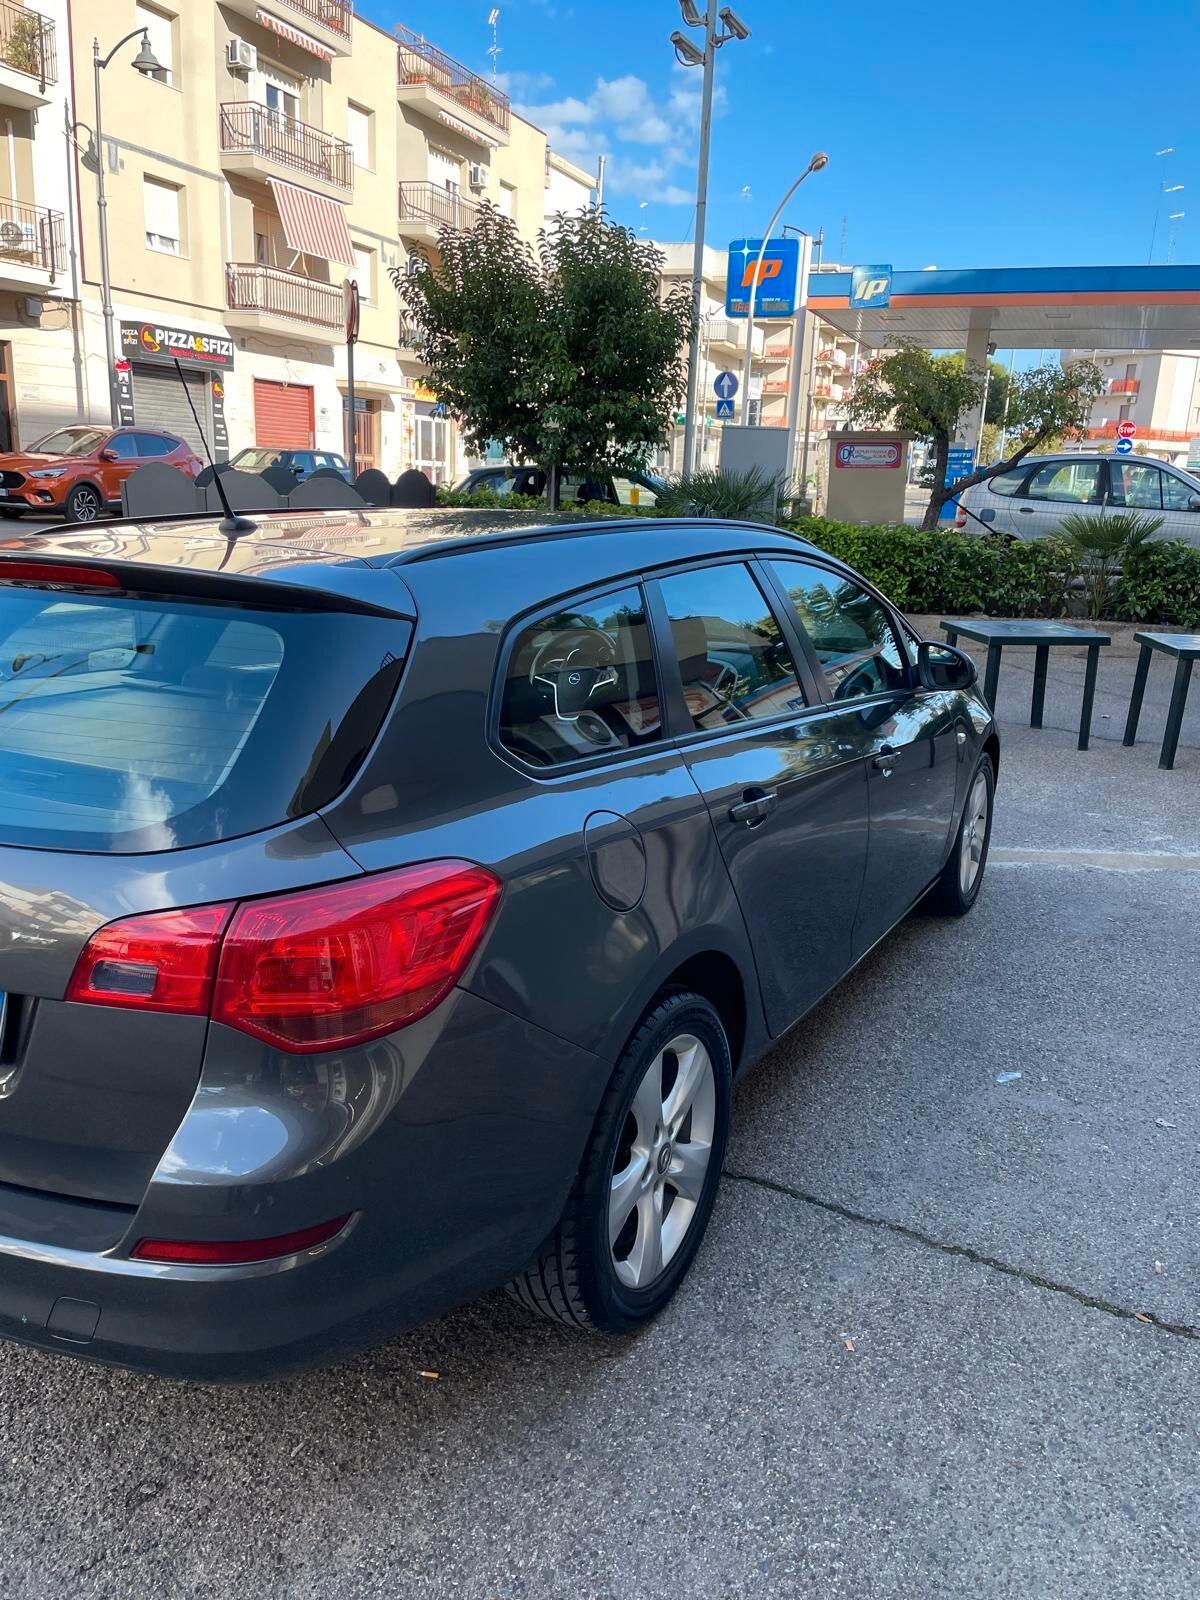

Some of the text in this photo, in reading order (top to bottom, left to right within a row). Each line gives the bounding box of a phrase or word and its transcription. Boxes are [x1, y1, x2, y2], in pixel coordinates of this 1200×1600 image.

[854, 279, 888, 301] IP
[121, 328, 138, 336] PIZZA
[1120, 426, 1135, 434] STOP
